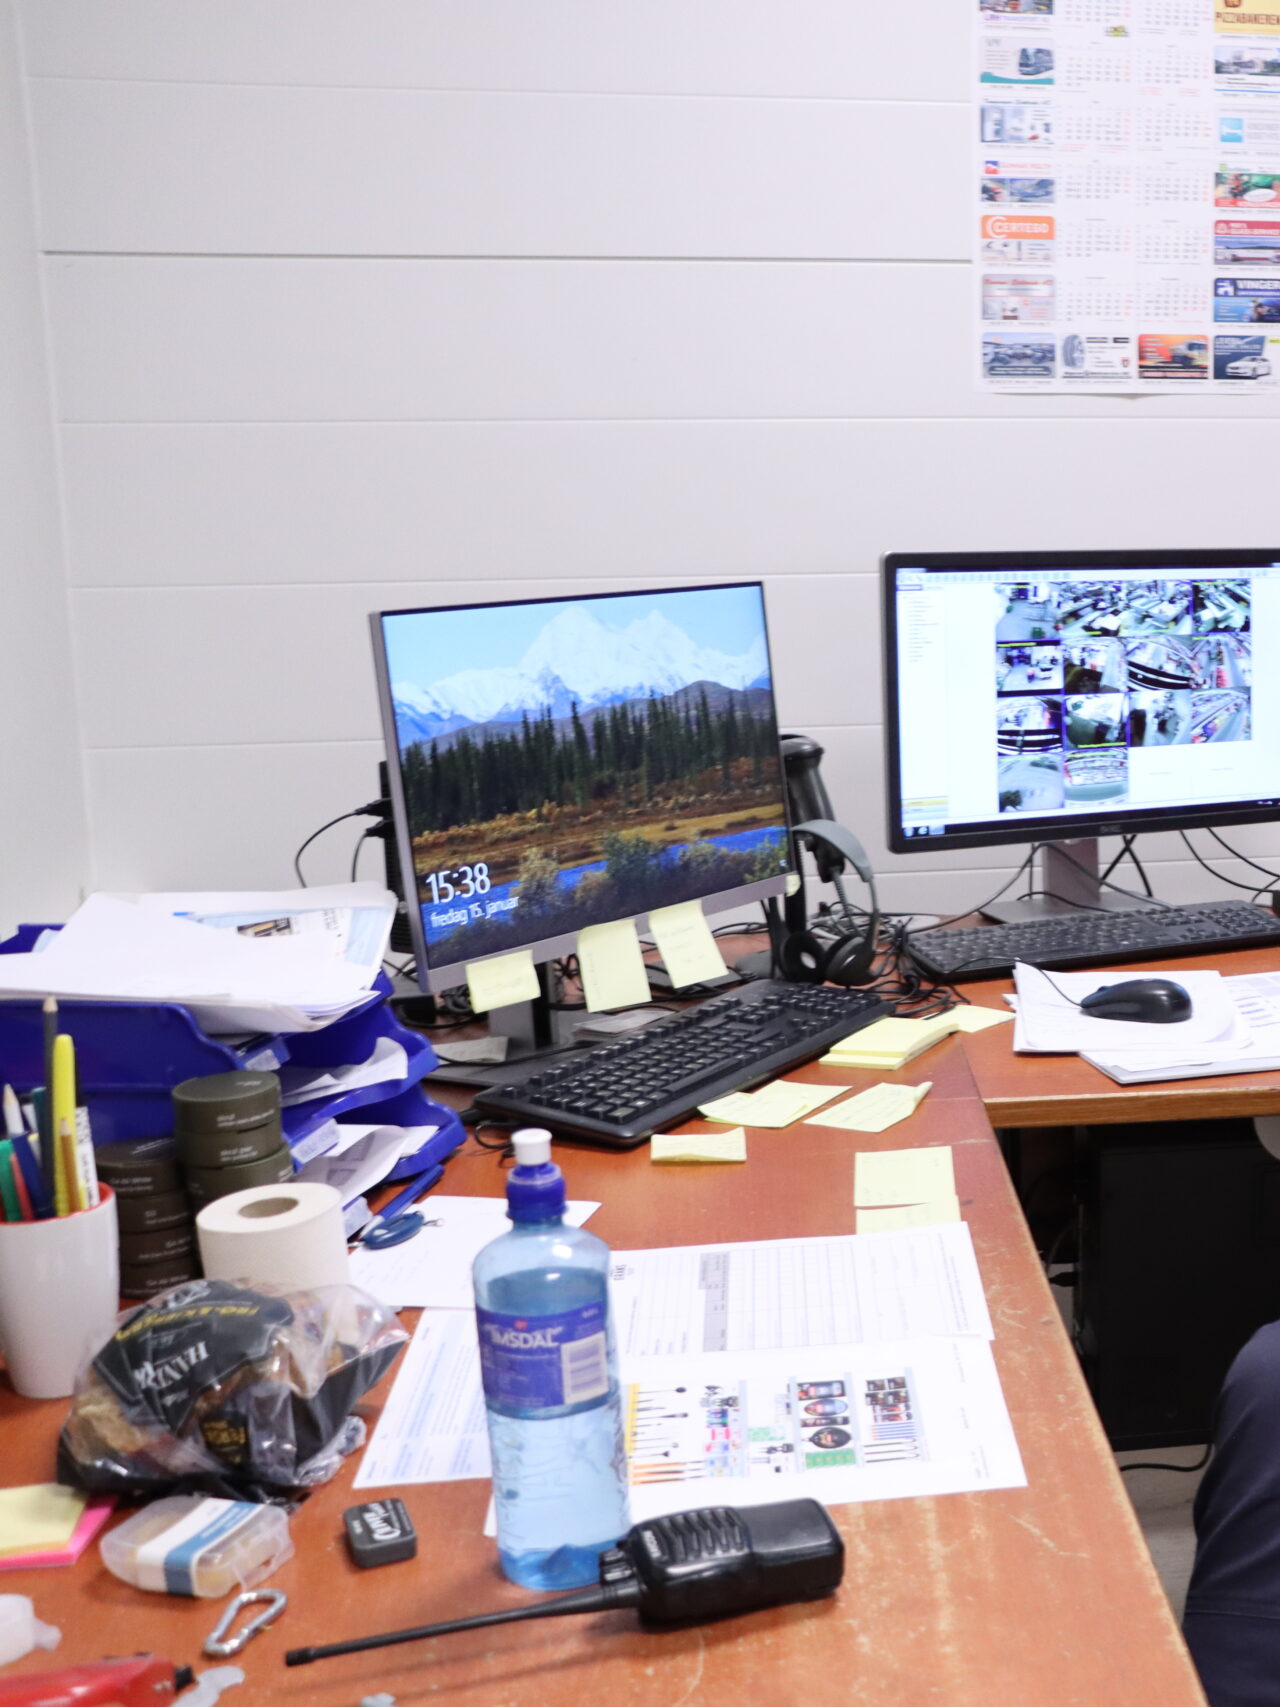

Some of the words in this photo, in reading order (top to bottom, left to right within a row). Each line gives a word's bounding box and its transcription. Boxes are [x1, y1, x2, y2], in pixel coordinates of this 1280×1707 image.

[425, 862, 491, 904] 15:38
[430, 908, 469, 928] fredag
[485, 896, 519, 919] januar
